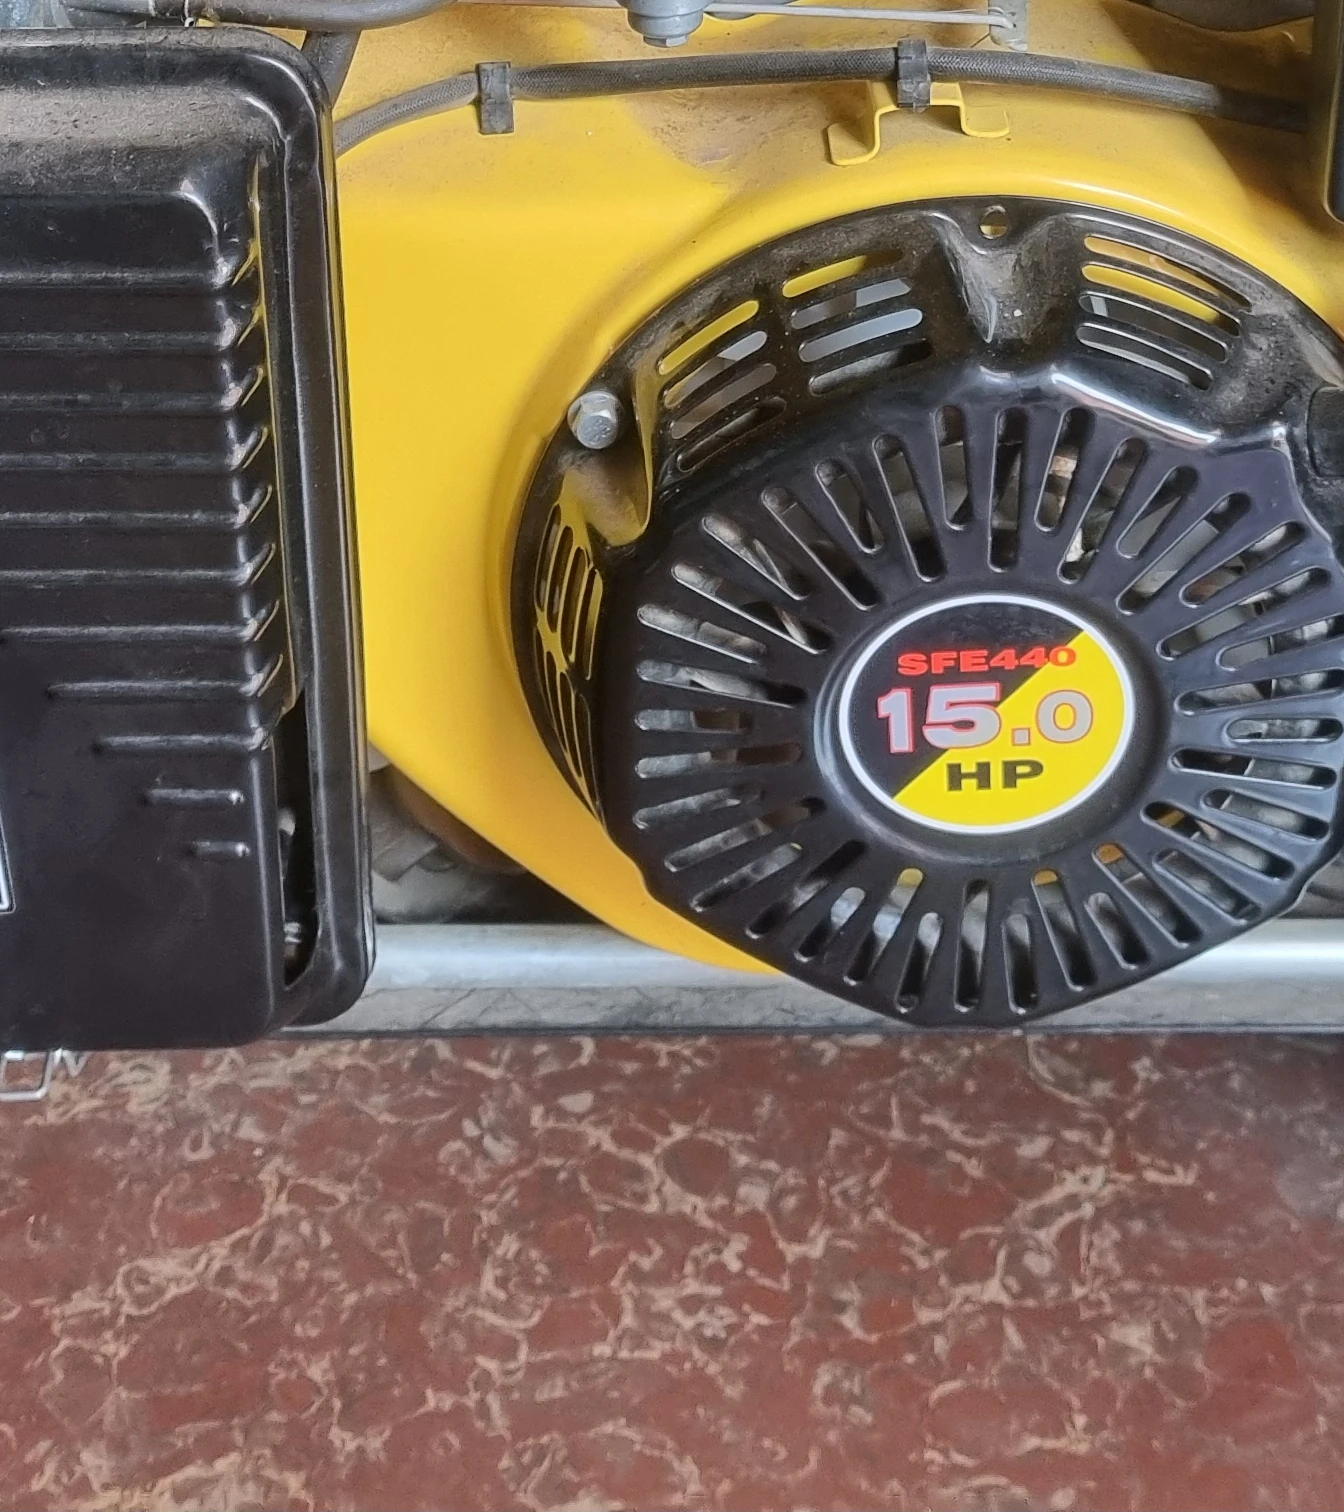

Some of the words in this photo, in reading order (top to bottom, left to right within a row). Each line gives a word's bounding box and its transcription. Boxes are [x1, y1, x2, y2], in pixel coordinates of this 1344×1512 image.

[897, 645, 1077, 676] SFE440
[876, 681, 1094, 754] 15.0
[946, 759, 1044, 792] HP
